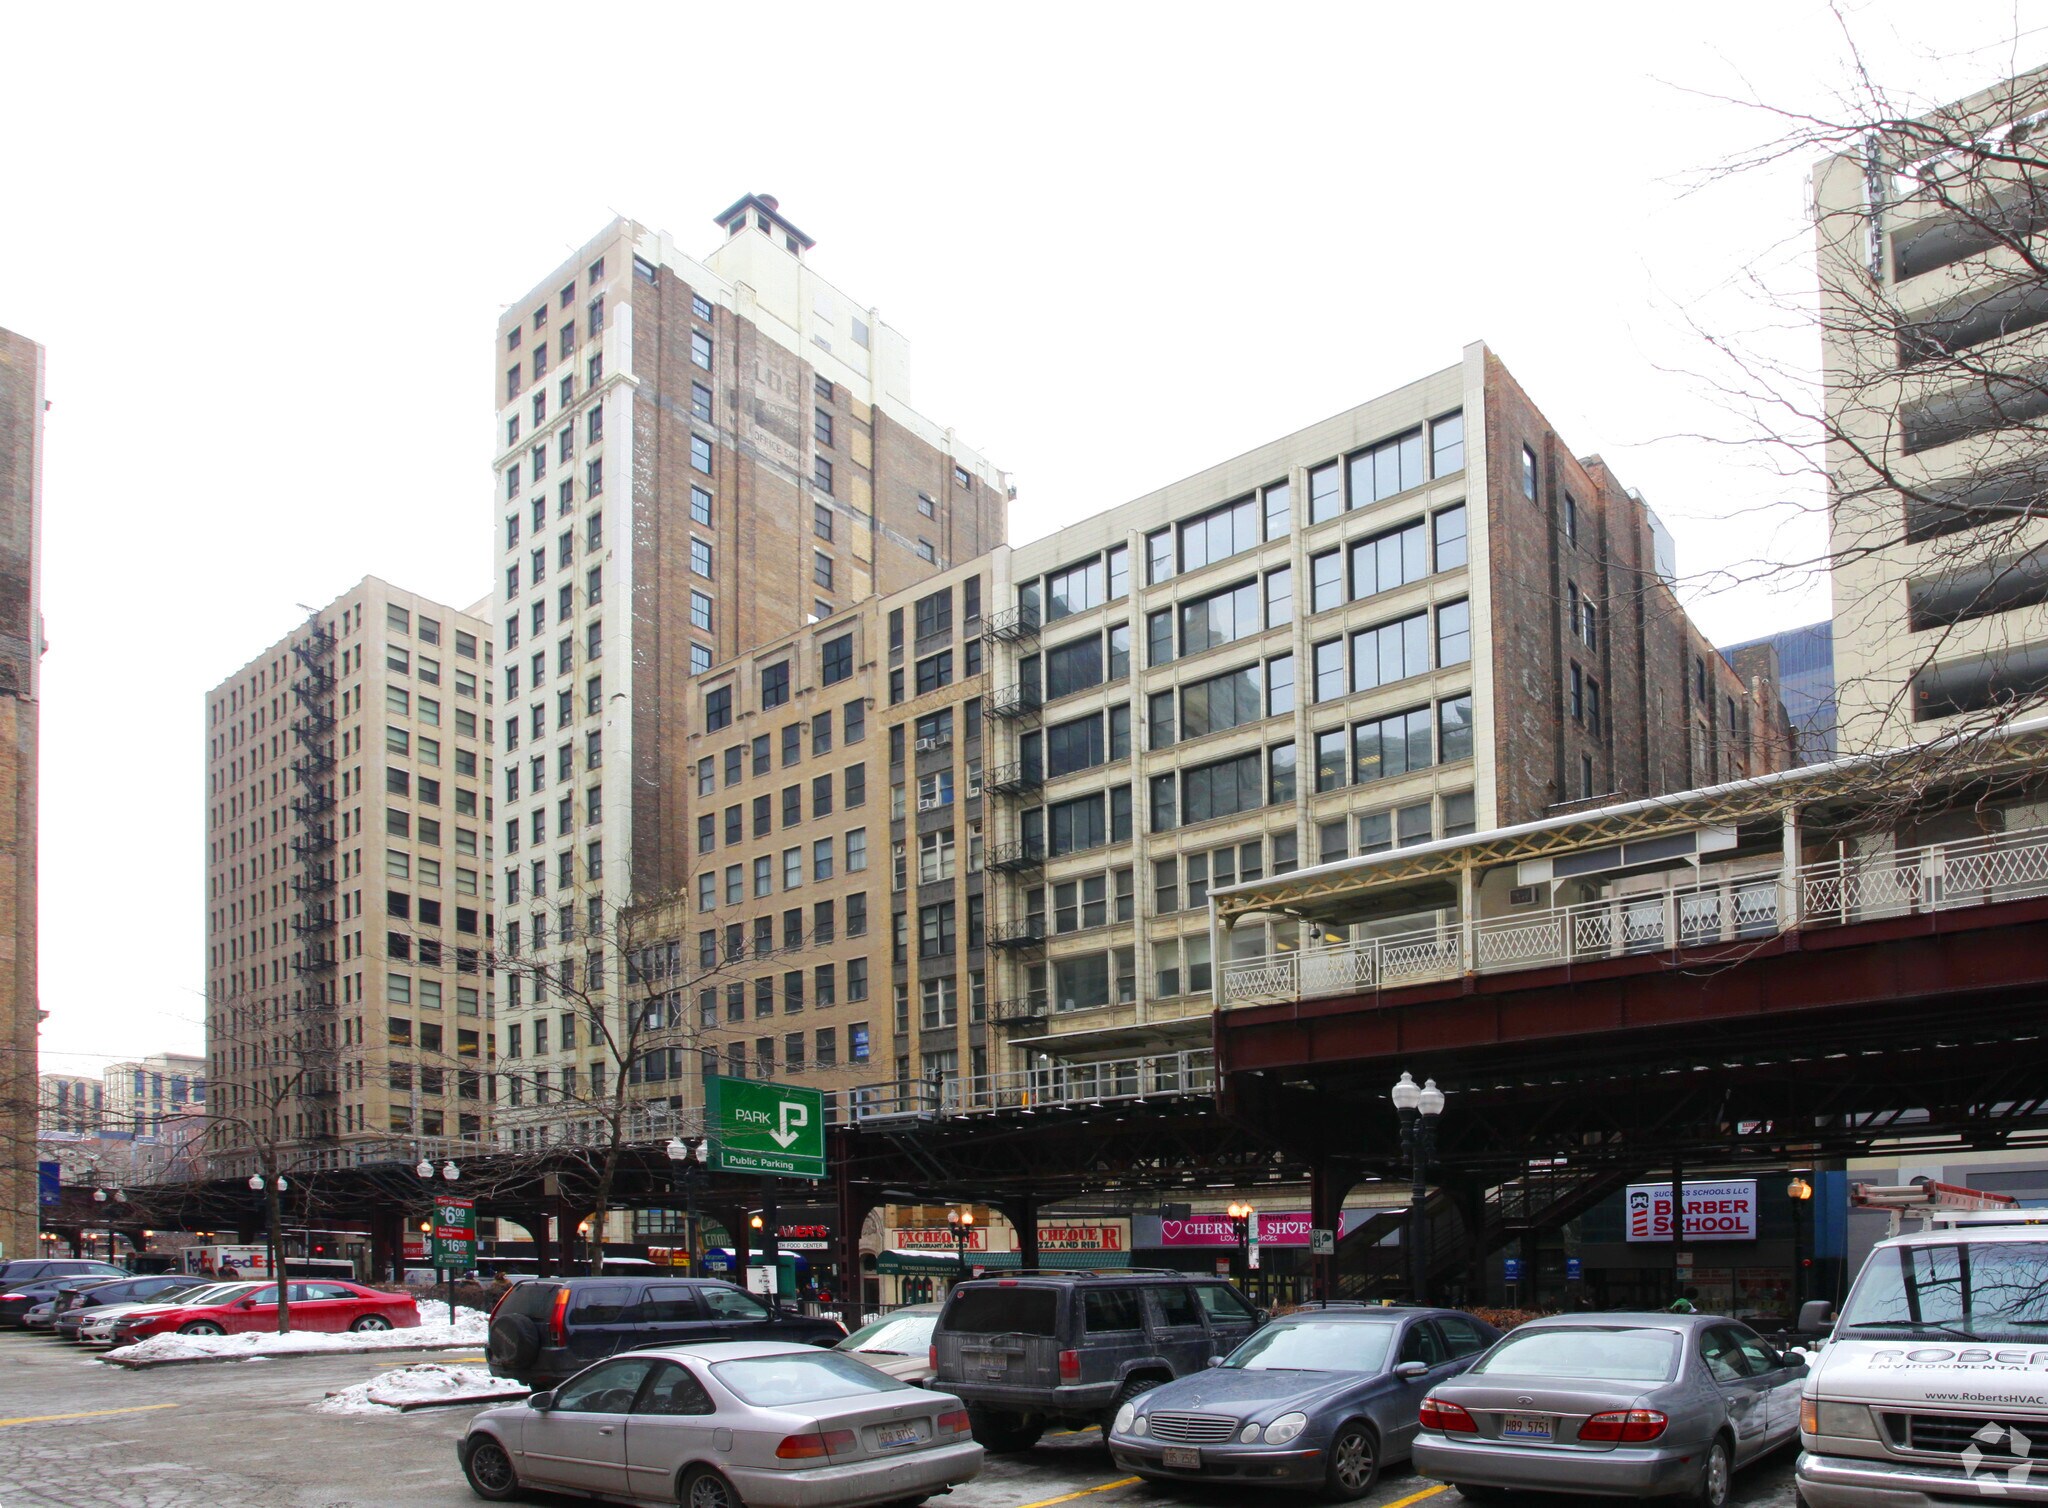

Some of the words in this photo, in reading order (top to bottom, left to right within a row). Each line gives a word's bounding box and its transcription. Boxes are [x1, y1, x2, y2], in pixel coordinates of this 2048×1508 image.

[735, 1109, 771, 1125] PARK
[729, 1155, 758, 1166] Public
[761, 1158, 794, 1170] Parking
[1654, 1188, 1691, 1198] SUCCSS
[1693, 1187, 1731, 1197] SCHOOLS
[1733, 1187, 1750, 1195] LLC
[1258, 1213, 1291, 1222] ENING
[778, 1225, 827, 1238] AMER'S
[1184, 1222, 1259, 1235] CHERN
[897, 1231, 980, 1249] EXCHEQR
[1016, 1228, 1119, 1249] CHEQUER
[1057, 1241, 1079, 1249] AND
[1081, 1241, 1101, 1249] RIBS
[187, 1250, 216, 1275] FedEx
[1925, 1392, 2048, 1405] www.RobertsHVAC.
[1505, 1419, 1522, 1432] H89
[1527, 1421, 1550, 1434] 5751
